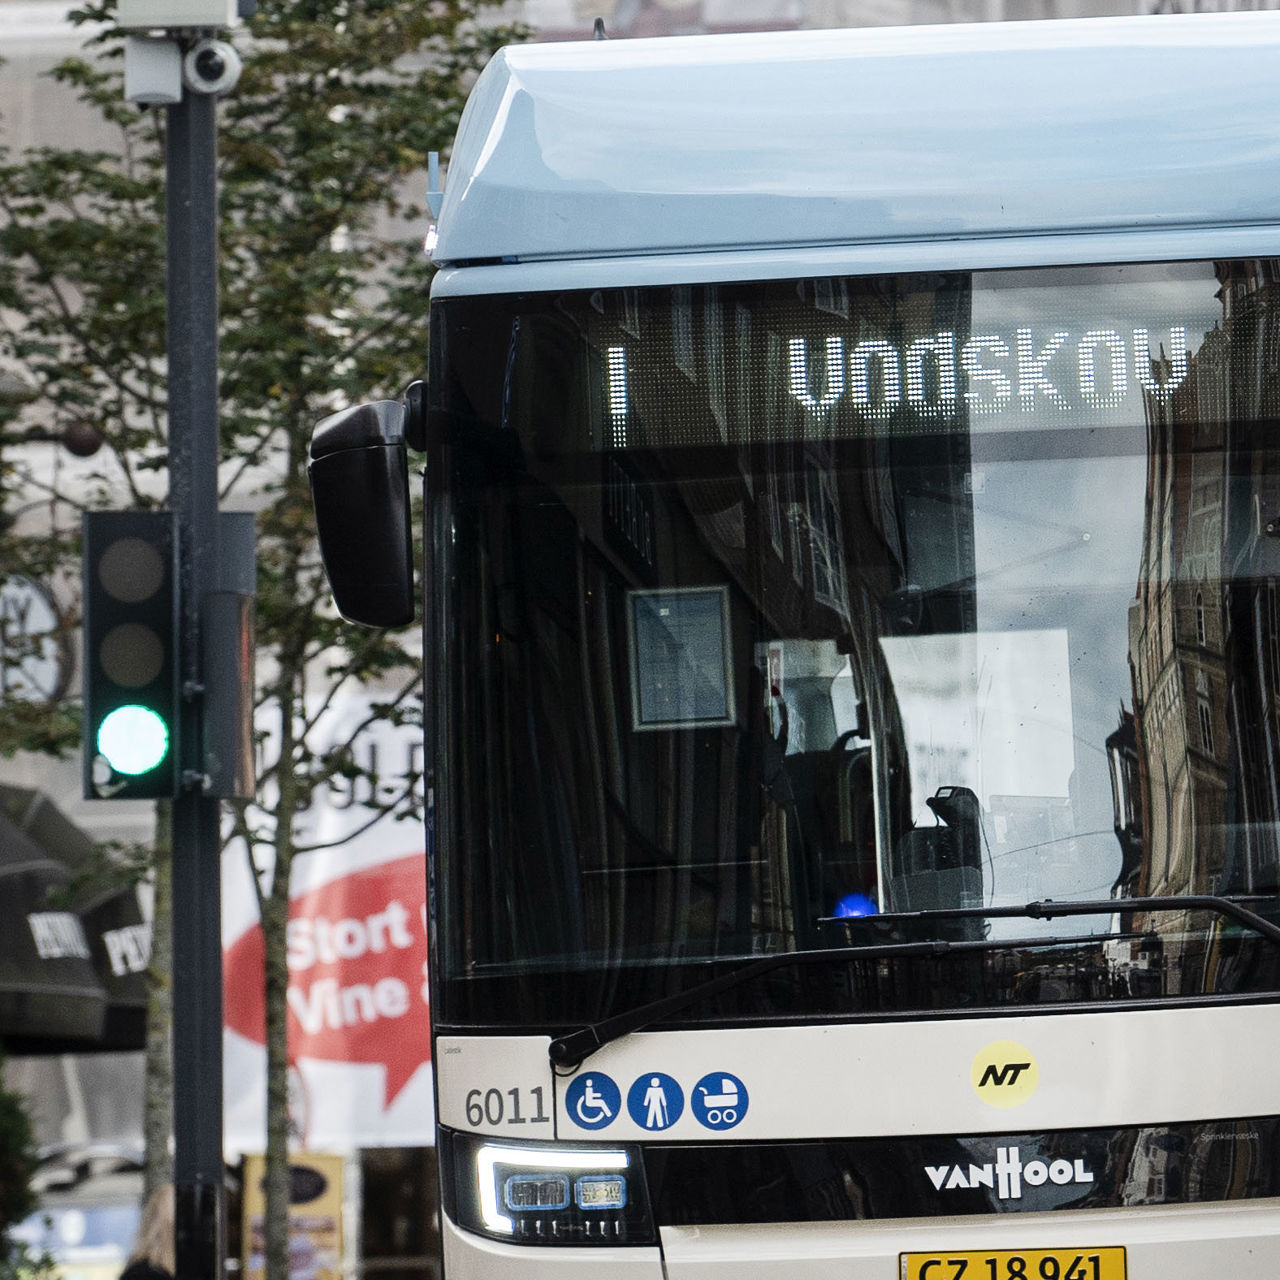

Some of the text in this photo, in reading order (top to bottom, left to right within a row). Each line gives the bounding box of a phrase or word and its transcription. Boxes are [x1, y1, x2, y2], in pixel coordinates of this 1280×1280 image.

[286, 901, 413, 970] Stort
[286, 975, 410, 1036] Vine
[978, 1062, 1031, 1087] NT
[465, 1086, 550, 1127] 6011
[918, 1255, 1101, 1280] CZ 18 941
